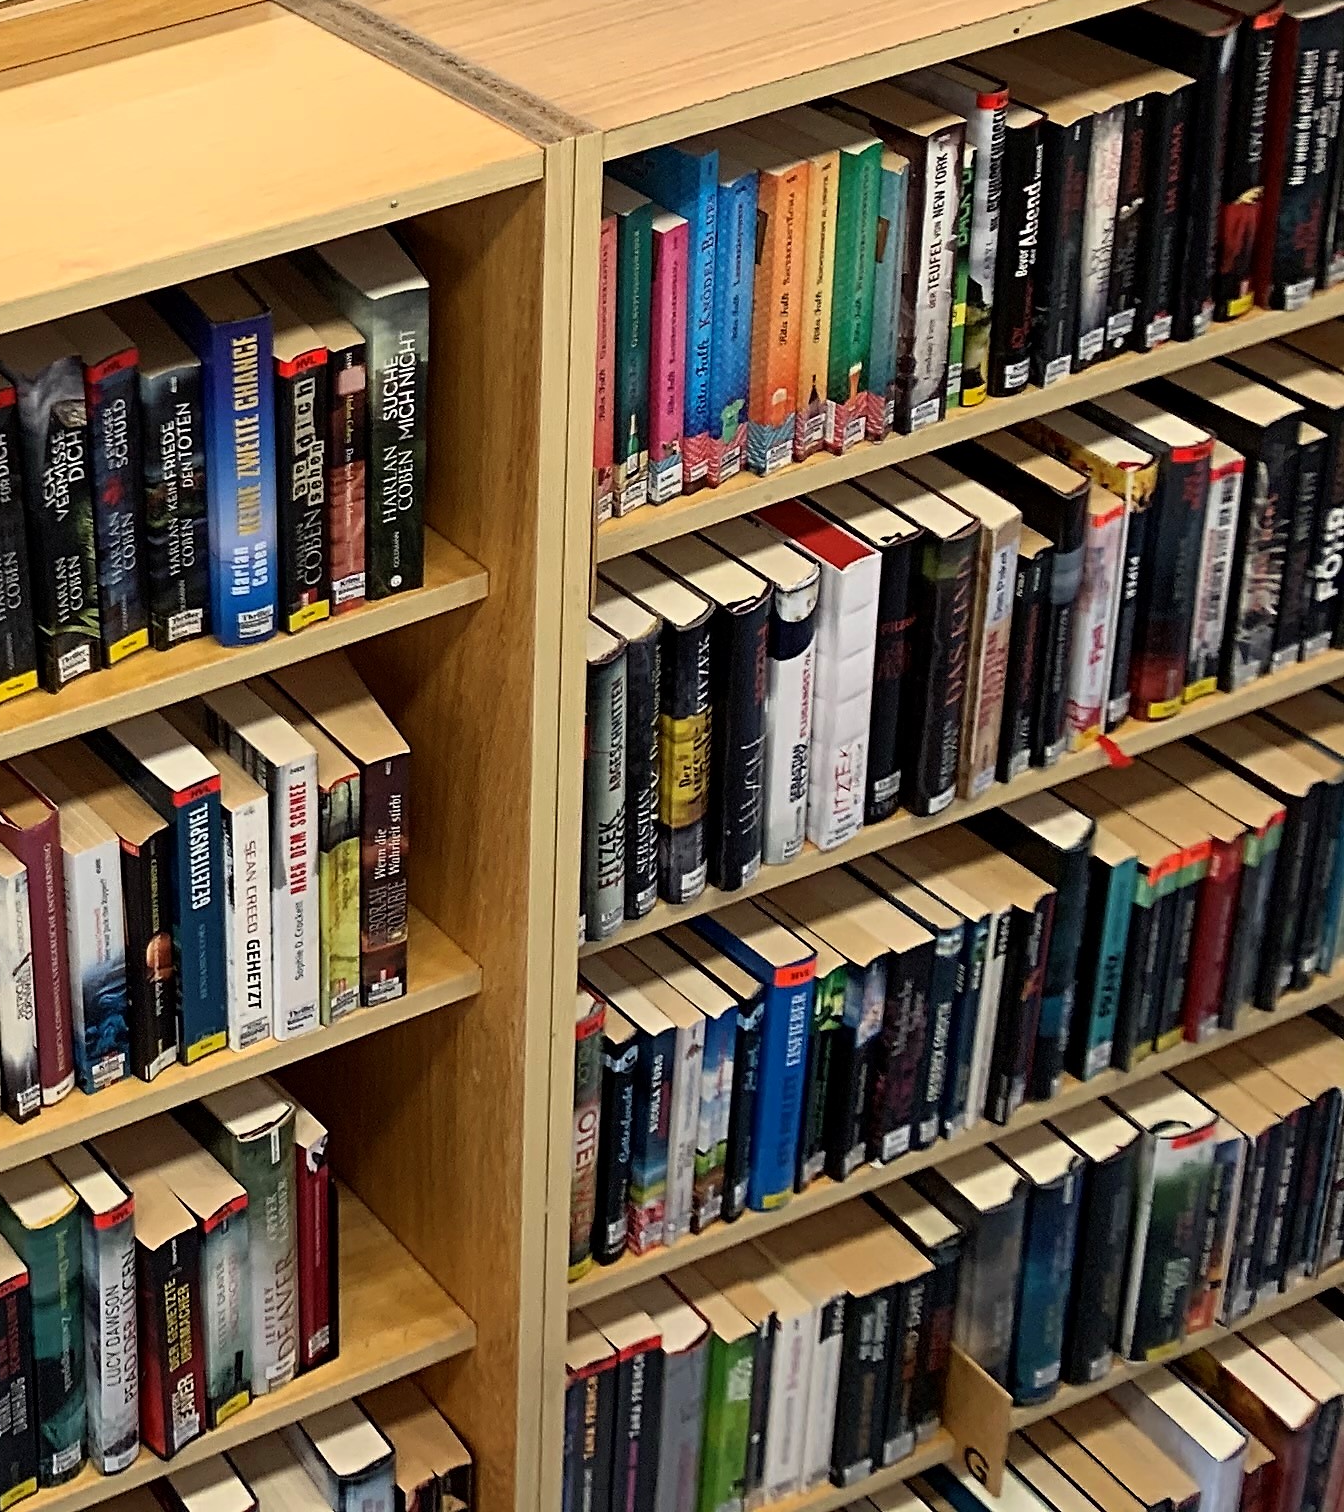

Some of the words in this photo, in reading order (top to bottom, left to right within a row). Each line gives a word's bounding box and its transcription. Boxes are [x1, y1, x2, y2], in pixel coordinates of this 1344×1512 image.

[934, 152, 949, 187] YORK
[931, 189, 947, 220] NEW
[933, 220, 942, 238] VON
[1018, 179, 1042, 247] Abend
[927, 239, 944, 289] TEUFEL
[1014, 248, 1028, 278] Bevor
[928, 288, 937, 309] DER
[232, 332, 259, 413] CHANCE
[398, 330, 417, 393] NICHT
[695, 337, 710, 379] Falk
[382, 354, 400, 422] SUCHE
[694, 381, 710, 418] Rita
[111, 398, 129, 470] SCHULD
[174, 402, 192, 462] TOTEN
[397, 394, 416, 441] MICH
[51, 428, 70, 522] VERMISSE
[68, 430, 86, 481] DICH
[161, 419, 176, 482] FRIEDE
[182, 461, 194, 489] DEN
[235, 412, 261, 481] ZWEITE
[166, 483, 179, 514] KEIN
[382, 444, 400, 524] HARLAN
[398, 447, 414, 513] COBEN
[238, 482, 262, 538] KEINE
[107, 511, 123, 584] HARLAN
[121, 511, 135, 571] COBEN
[167, 516, 182, 578] HARLAN
[180, 518, 195, 569] COBEN
[252, 541, 269, 588] Coben
[303, 508, 323, 585] COBEN
[2, 550, 21, 611] COBEN
[53, 555, 71, 624] HARLAN
[66, 554, 84, 612] COBEN
[230, 545, 250, 597] Harlan
[696, 633, 711, 713] FITZEK
[608, 675, 625, 793] ABGESCHNITTEN
[288, 780, 308, 828] SCHNEE
[388, 794, 402, 825] stirbt
[636, 788, 653, 875] SEBASTIAN
[186, 802, 211, 910] GEZEITENSPIEL
[243, 840, 256, 883] SEAN
[289, 829, 308, 860] DEM
[373, 853, 388, 880] Wenn
[375, 827, 388, 853] die
[387, 826, 402, 874] Wahrheit
[596, 821, 612, 890] FITZEK
[290, 860, 309, 896] NACH
[244, 883, 259, 934] CREED
[245, 938, 263, 1010] GEHETZT
[785, 992, 807, 1068] EISFIEBER
[104, 1283, 120, 1348] DAWSON
[106, 1352, 123, 1388] LUCY
